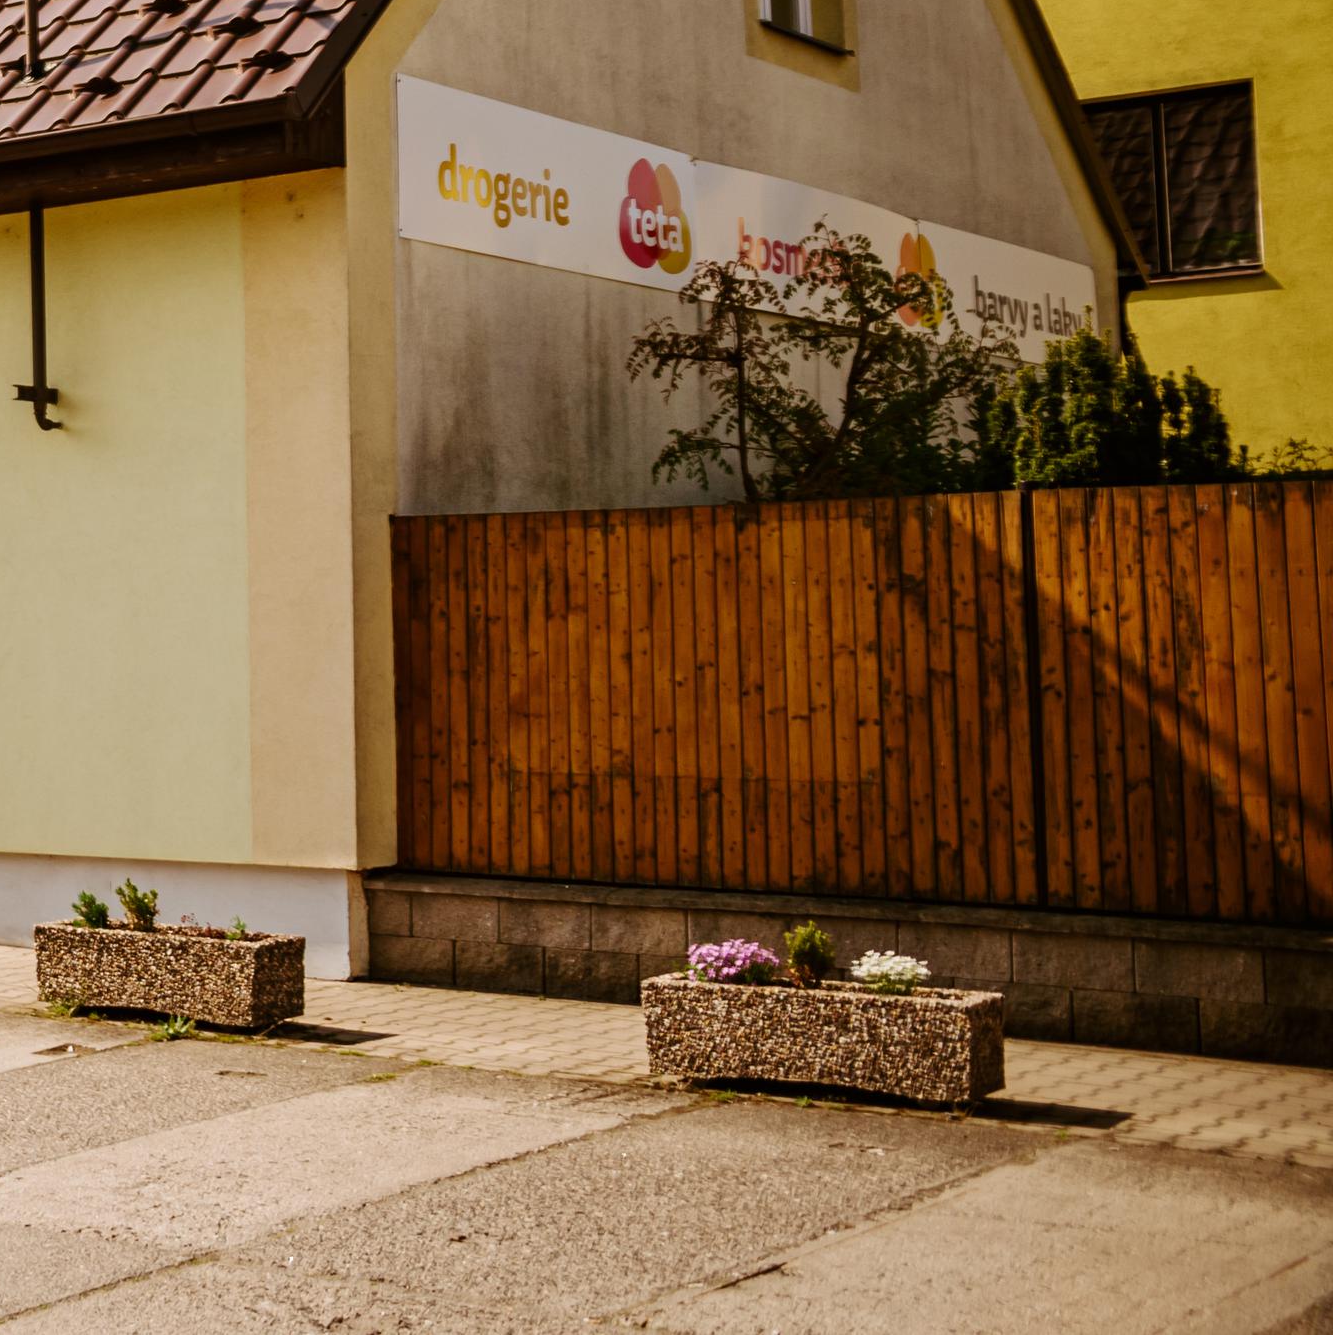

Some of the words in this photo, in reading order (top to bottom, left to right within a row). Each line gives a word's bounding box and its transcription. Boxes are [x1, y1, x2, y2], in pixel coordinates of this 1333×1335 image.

[438, 143, 570, 228] drogerie
[628, 198, 683, 253] teta
[974, 274, 1028, 338] barvy
[1033, 302, 1044, 332] a
